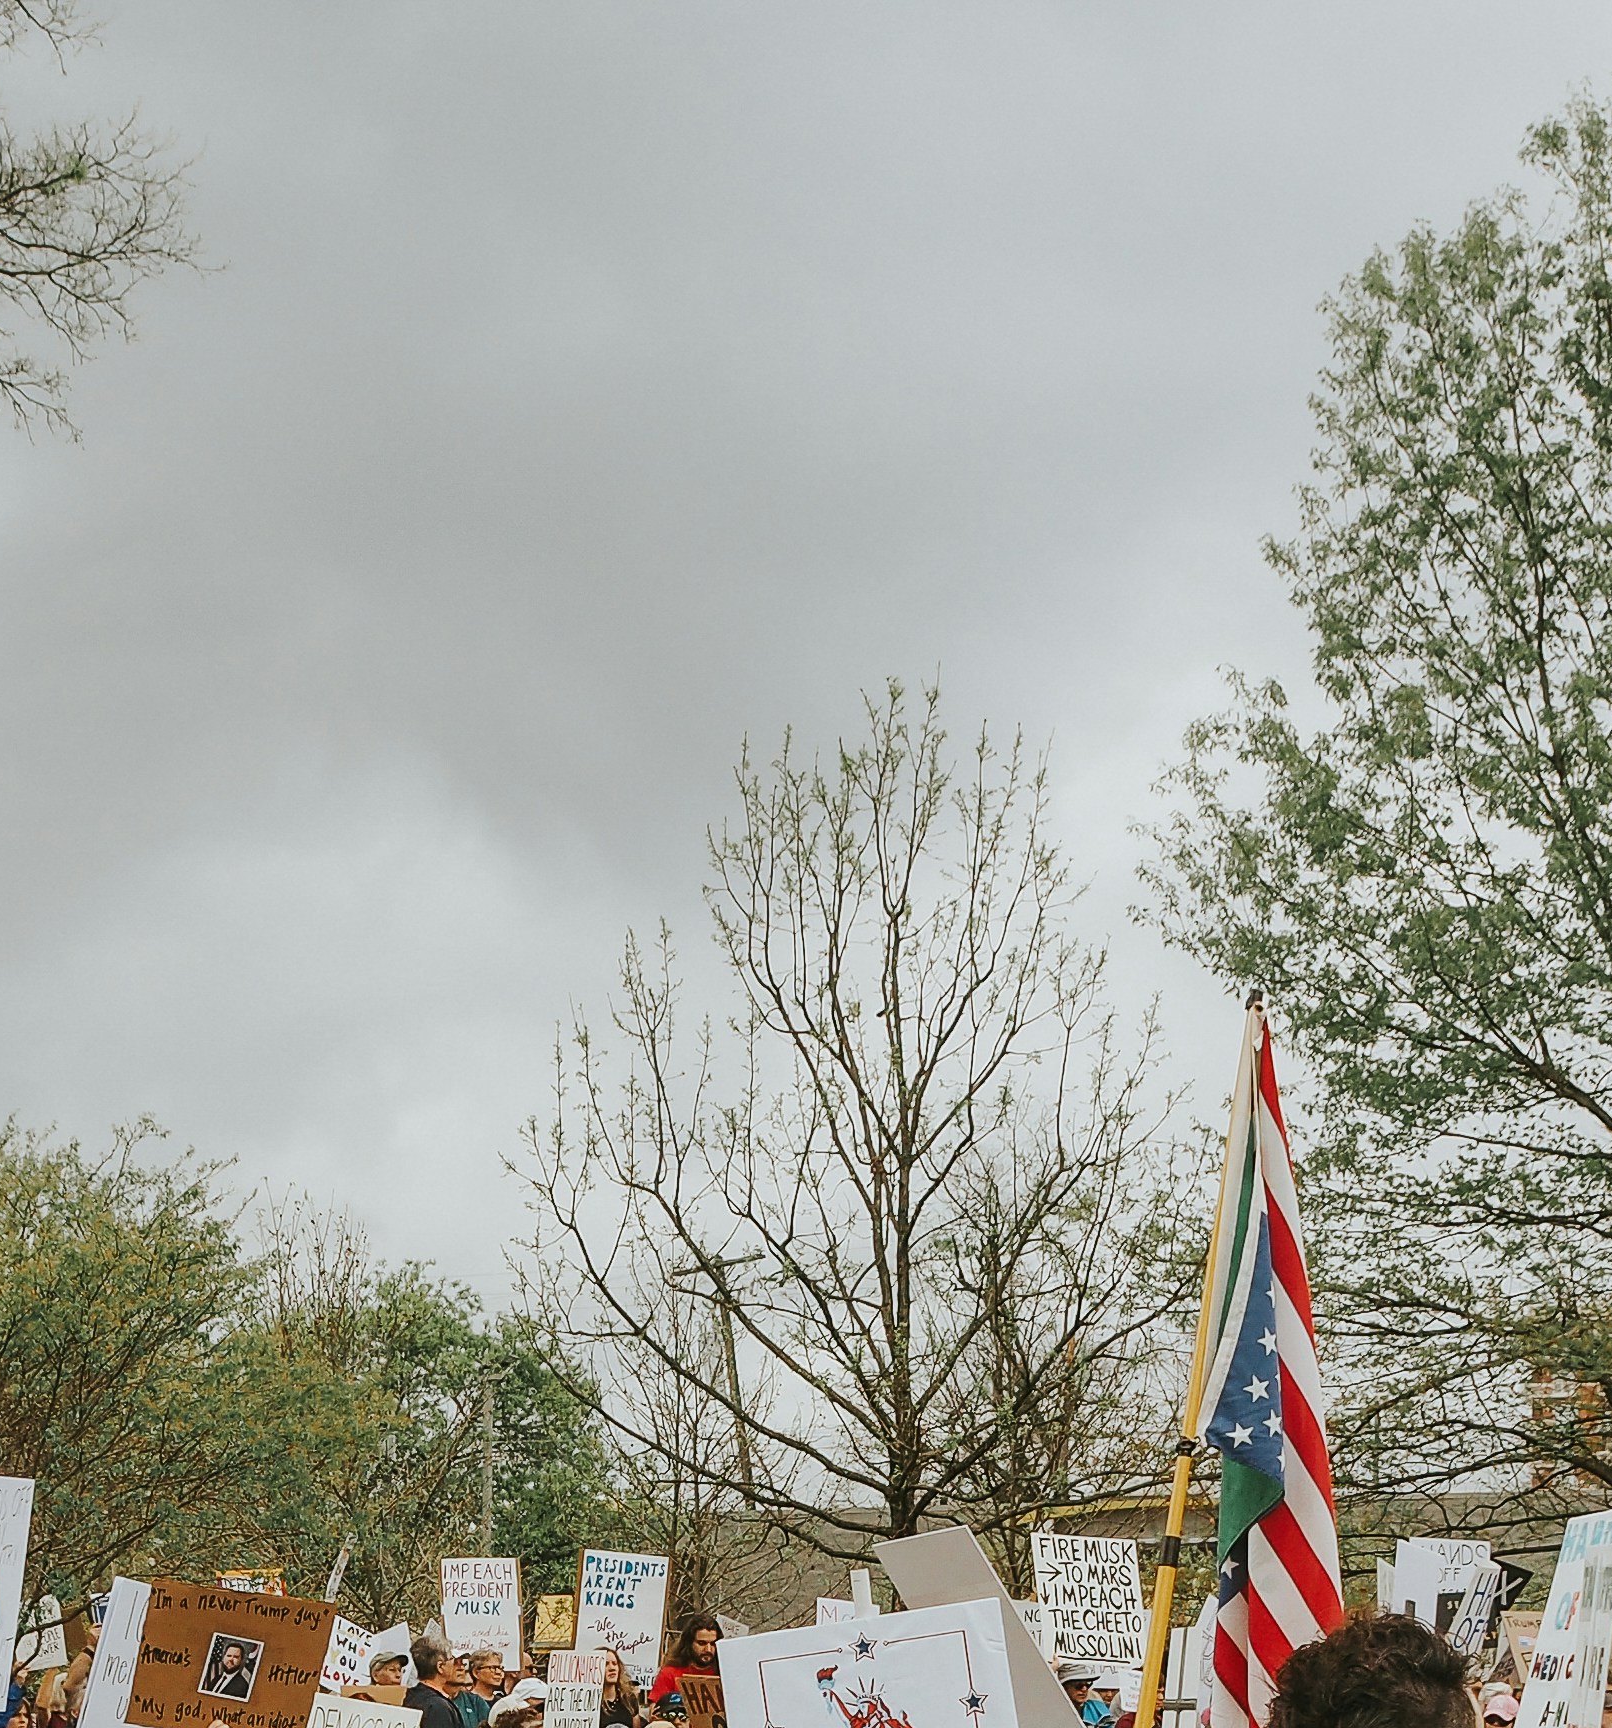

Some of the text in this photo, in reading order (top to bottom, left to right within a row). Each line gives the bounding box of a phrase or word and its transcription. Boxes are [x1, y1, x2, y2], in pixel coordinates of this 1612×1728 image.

[1038, 1537, 1135, 1565] FIRE MUSK
[443, 1563, 513, 1580] IMPEACH
[585, 1555, 666, 1578] PRESIDENTS
[1058, 1562, 1132, 1587] TO MARS
[444, 1582, 513, 1599] PRESIDENT
[584, 1574, 642, 1592] AREN'T
[454, 1600, 501, 1616] MUSK
[585, 1590, 635, 1609] KINGS
[1054, 1583, 1138, 1611] IMPEACH
[179, 1597, 188, 1610] a
[197, 1595, 239, 1612] never
[246, 1599, 291, 1625] Trump
[1048, 1609, 1082, 1632] THE
[1083, 1609, 1142, 1634] CHEETO
[337, 1618, 375, 1648] LOVE
[604, 1631, 629, 1643] the
[615, 1632, 654, 1655] People
[336, 1634, 366, 1658] WHO
[1054, 1631, 1143, 1660] MUSSOLINI
[550, 1653, 606, 1686] BILLIONAIRES
[547, 1687, 603, 1713] ARE THE ONLY
[246, 1712, 265, 1726] an
